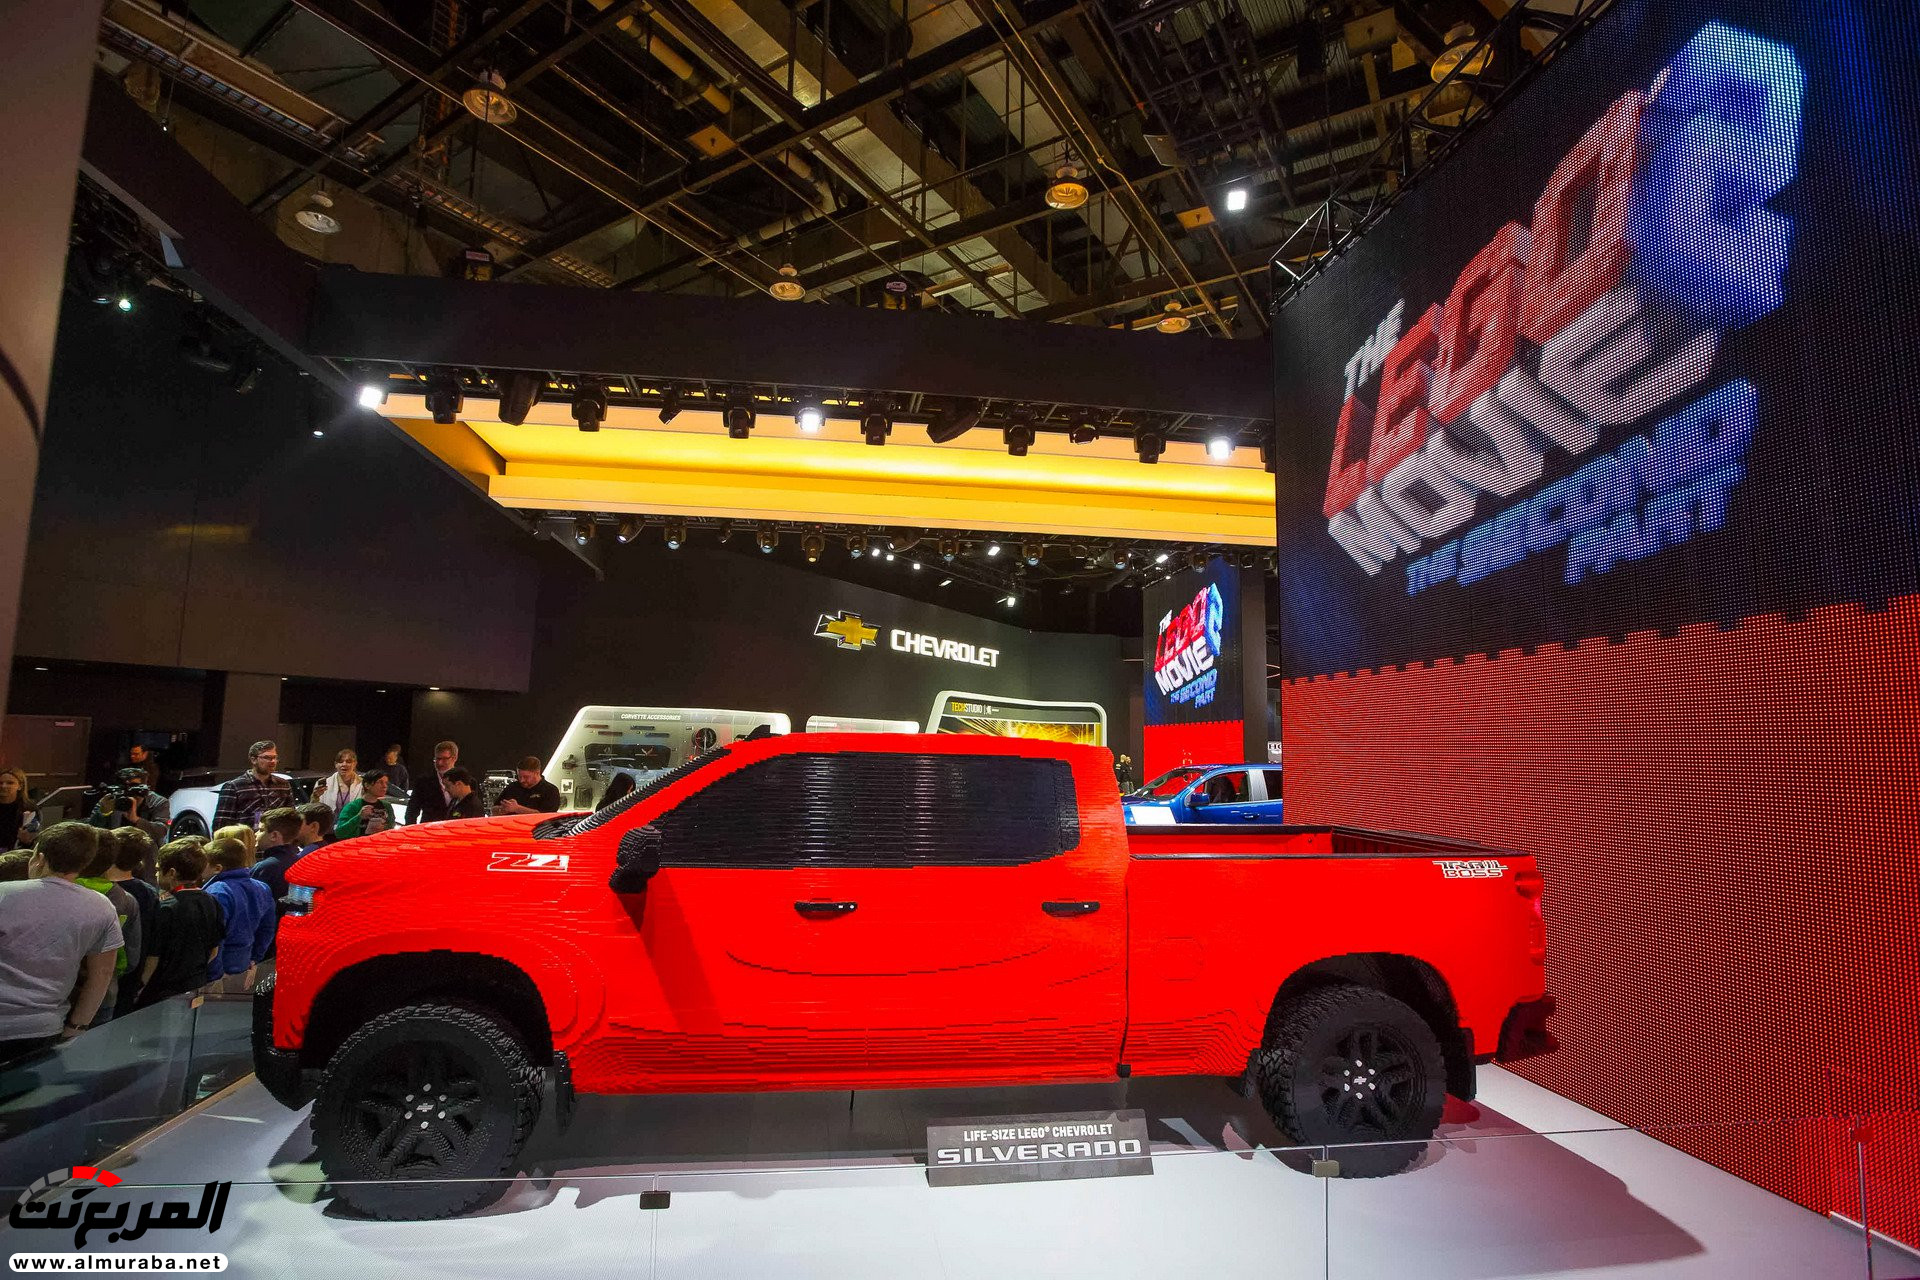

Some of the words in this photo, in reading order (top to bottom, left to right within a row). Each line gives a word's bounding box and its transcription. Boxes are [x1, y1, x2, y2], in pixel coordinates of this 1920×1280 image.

[1323, 88, 1643, 517] LEGO
[1344, 298, 1405, 402] THE
[1328, 282, 1722, 576] MOVIE
[890, 629, 1000, 667] CHEVROLET
[1154, 587, 1207, 672] LEGO
[1155, 635, 1214, 695] MOVIE
[487, 852, 569, 873] Z71
[1443, 869, 1503, 878] BOSS
[937, 1139, 1142, 1164] SILVERADO
[964, 1128, 1016, 1142] LIFE-SIZE
[1052, 1123, 1113, 1138] CHEVROLET
